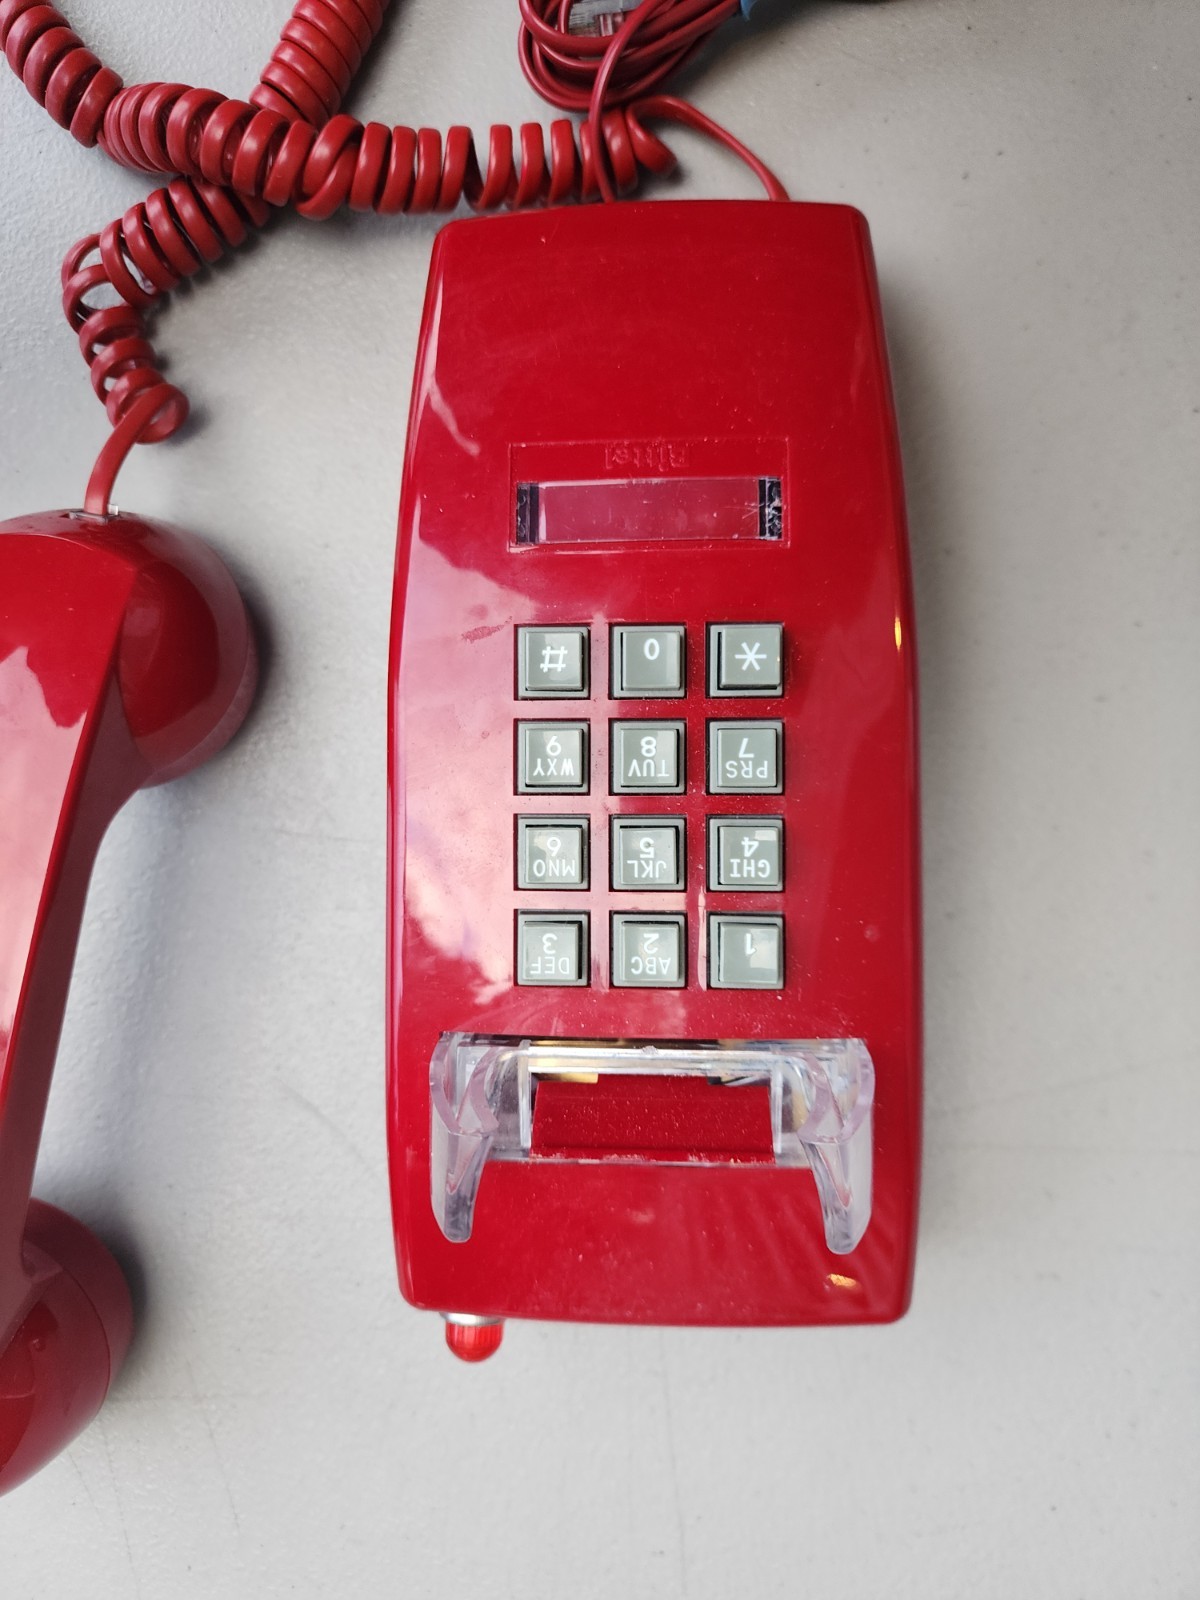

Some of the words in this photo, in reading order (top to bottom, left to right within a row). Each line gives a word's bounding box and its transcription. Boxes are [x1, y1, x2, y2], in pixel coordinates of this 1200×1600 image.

[546, 735, 562, 757] 9
[640, 736, 657, 758] 8
[738, 737, 755, 758] 7
[533, 758, 575, 777] WXY
[628, 759, 670, 777] TUV
[725, 760, 768, 779] PRS
[546, 836, 562, 857] 6
[639, 837, 655, 859] 5
[741, 837, 759, 858] 4
[533, 859, 576, 877] MNO
[627, 860, 667, 879] JKL
[730, 858, 771, 878] GHI
[542, 933, 558, 955] 3
[643, 933, 659, 954] 2
[744, 933, 757, 956] 1
[530, 956, 570, 975] DEF
[631, 956, 671, 976] ABC
